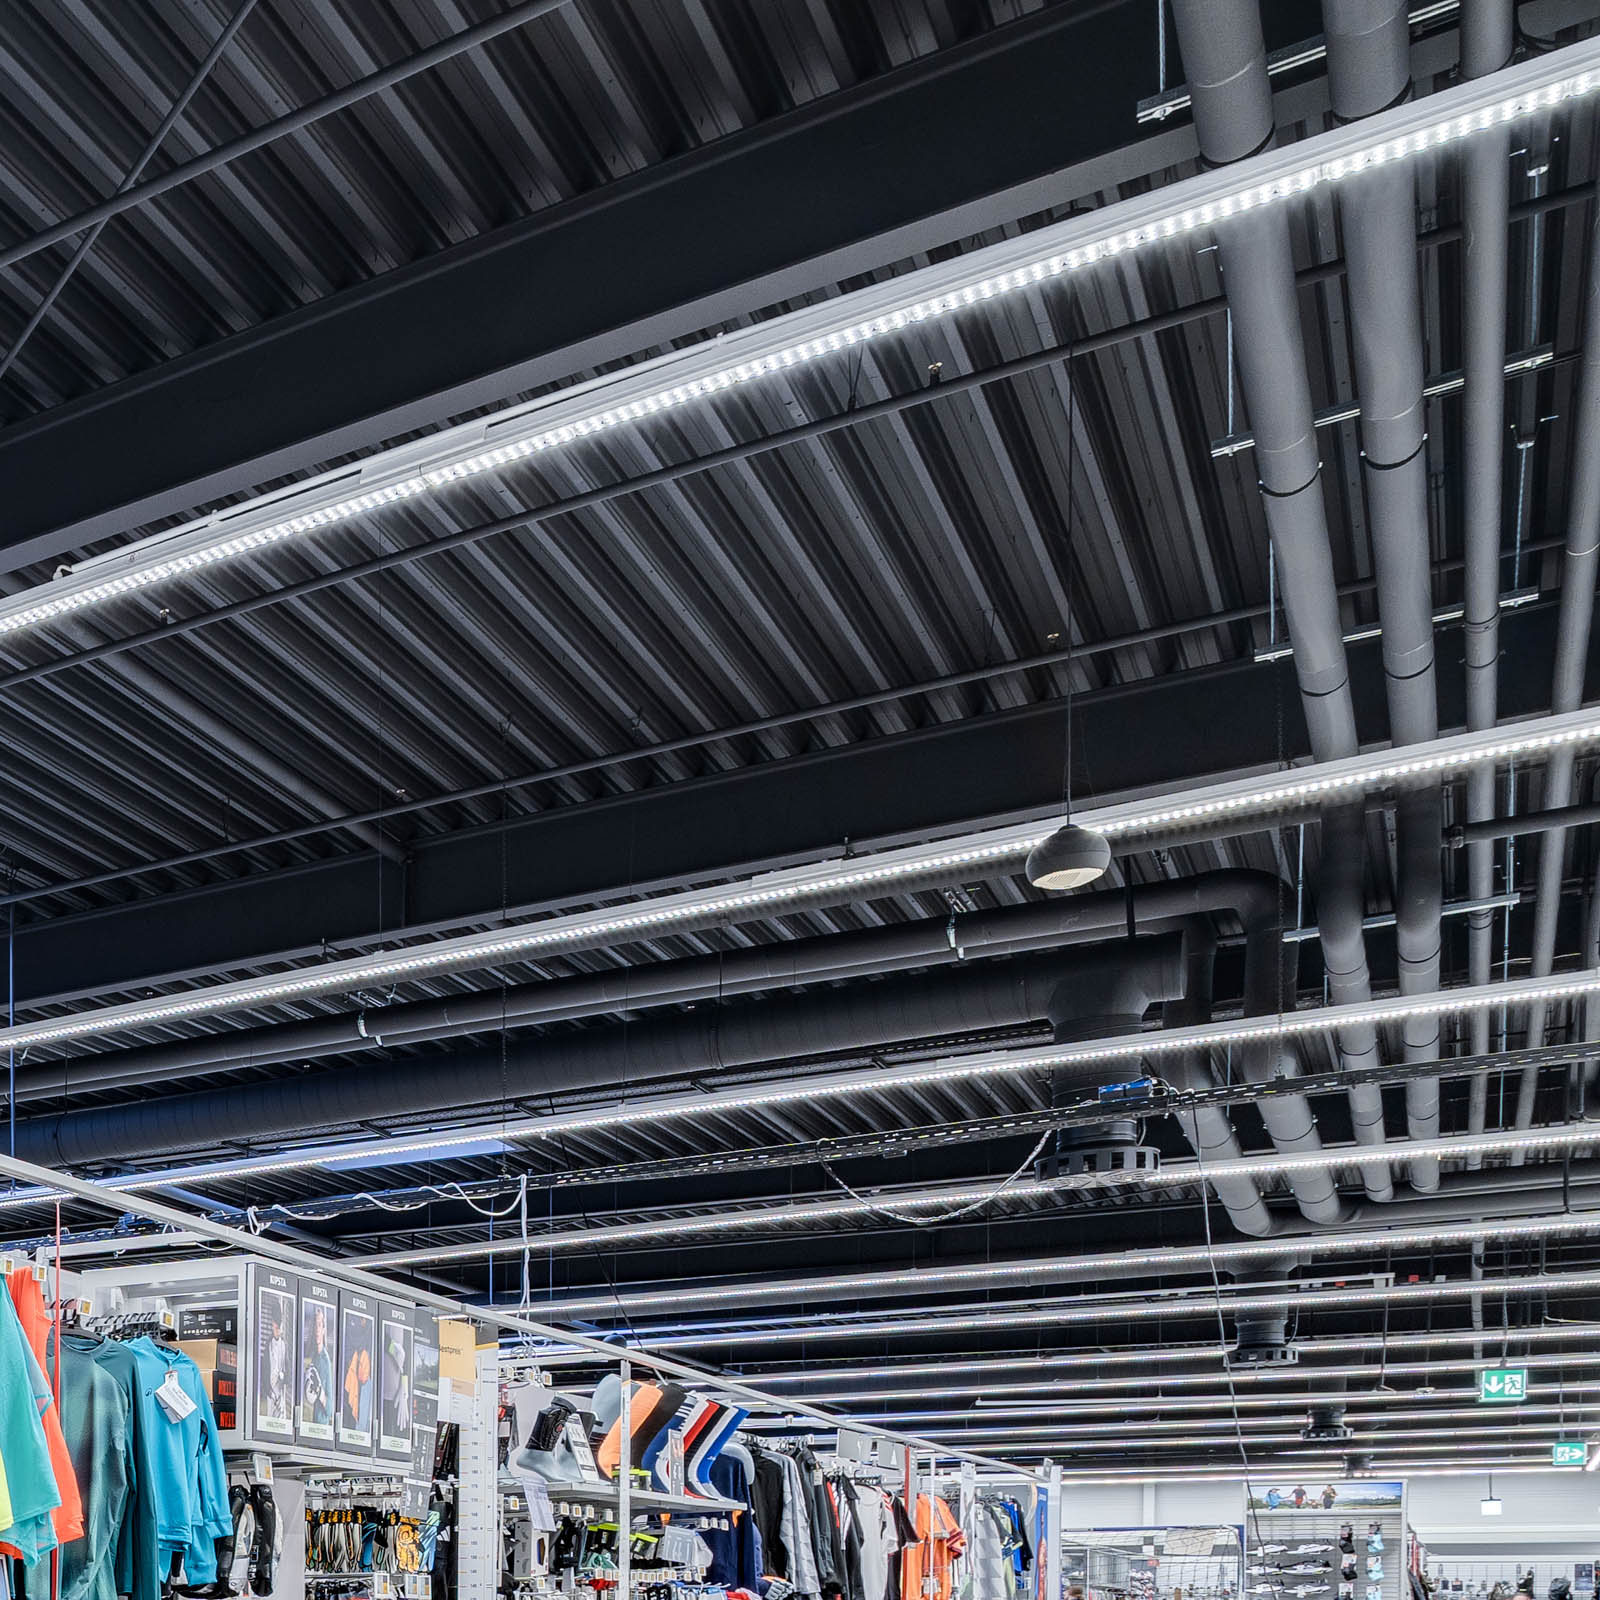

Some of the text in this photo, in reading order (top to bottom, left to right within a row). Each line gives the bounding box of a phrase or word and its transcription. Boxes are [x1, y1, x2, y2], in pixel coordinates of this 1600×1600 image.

[269, 1274, 287, 1287] KIPSTA
[312, 1286, 328, 1299] KIPSTA
[352, 1297, 367, 1310] KIPSTA
[391, 1309, 406, 1321] KIPSTA
